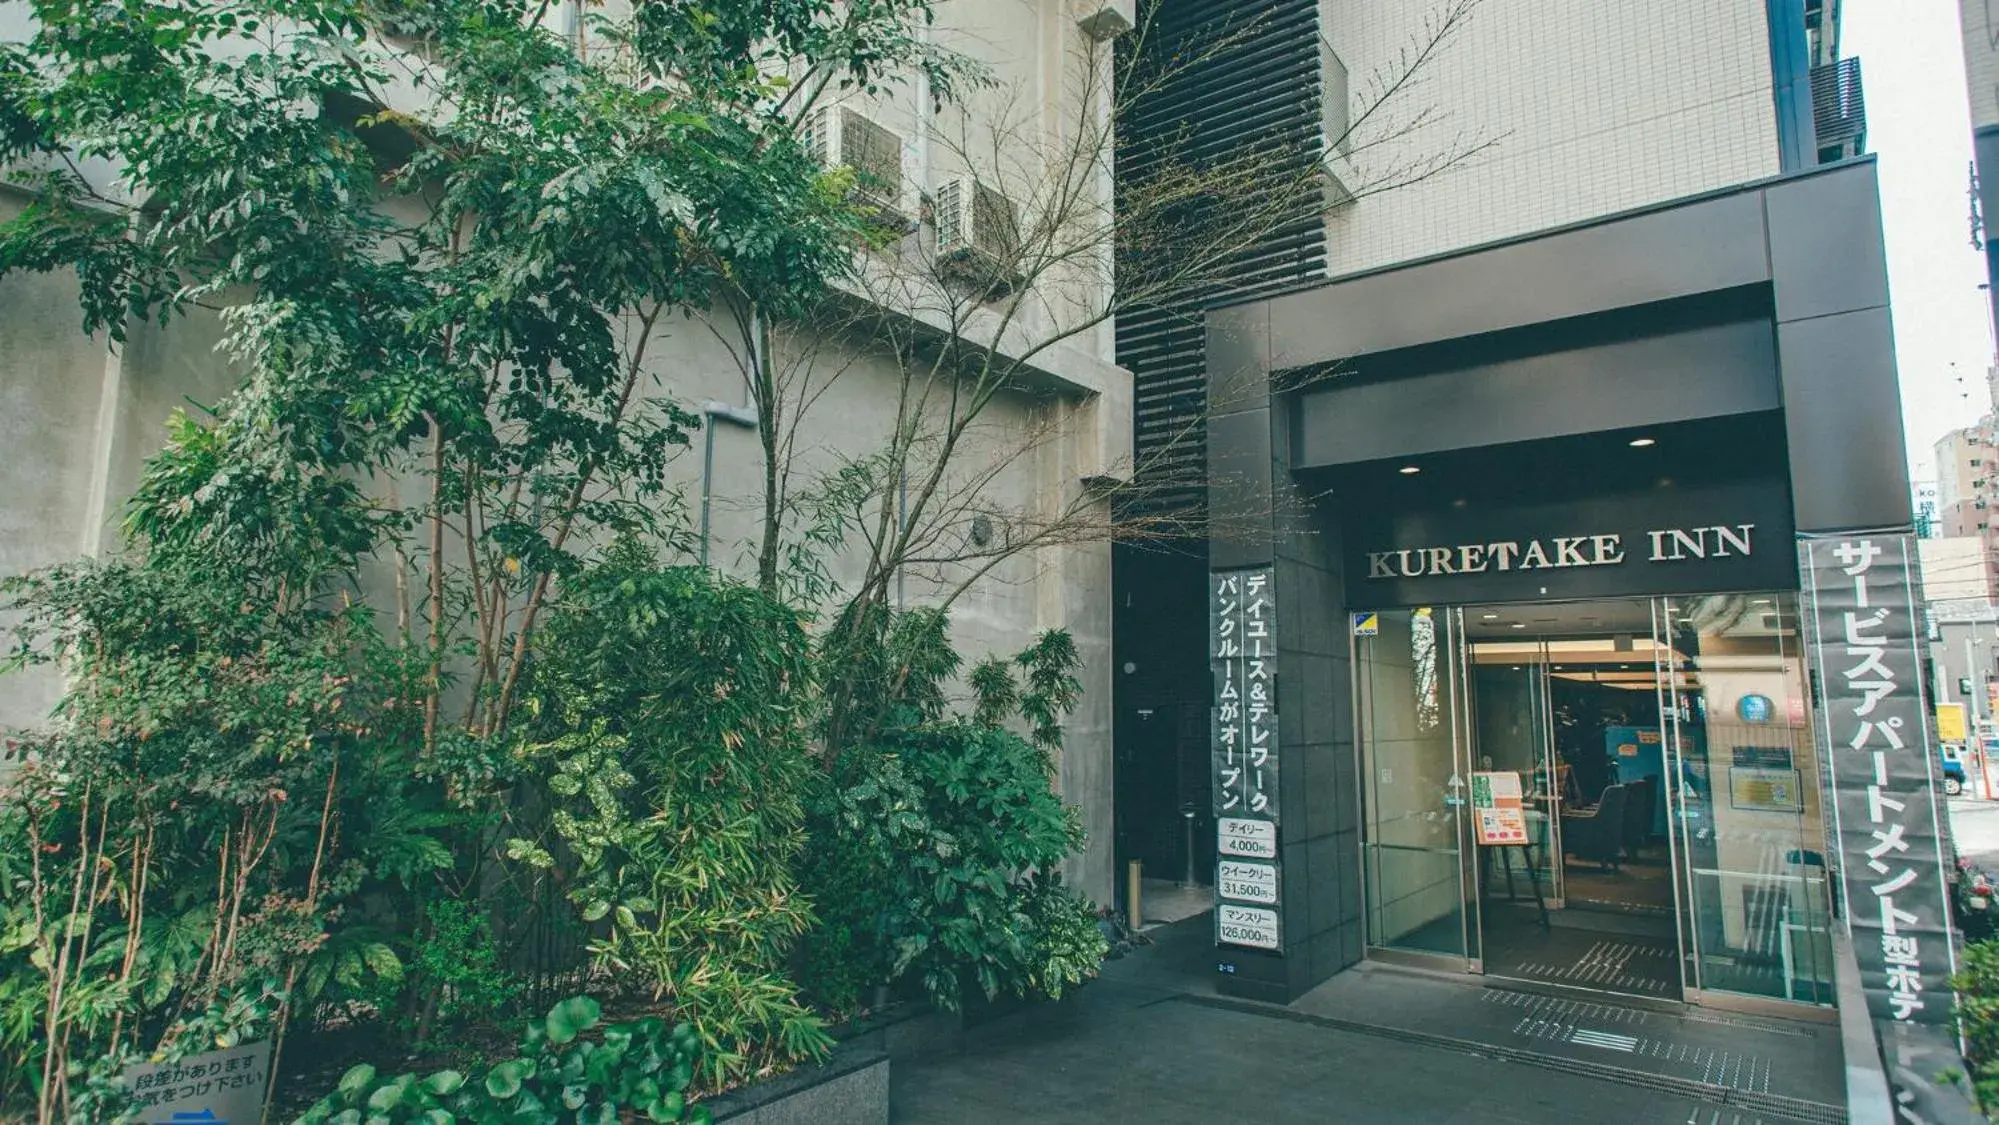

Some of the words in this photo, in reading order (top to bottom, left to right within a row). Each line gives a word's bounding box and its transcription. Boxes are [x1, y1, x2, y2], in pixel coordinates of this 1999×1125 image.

[1367, 534, 1625, 579] KURETAKE
[1646, 524, 1755, 561] INN
[1217, 575, 1241, 810] バンクルームがオープン
[1832, 541, 1925, 1022] サービスアパートメント型ホテ
[1225, 909, 1271, 923] マンスリー
[136, 1055, 257, 1090] 段差があります
